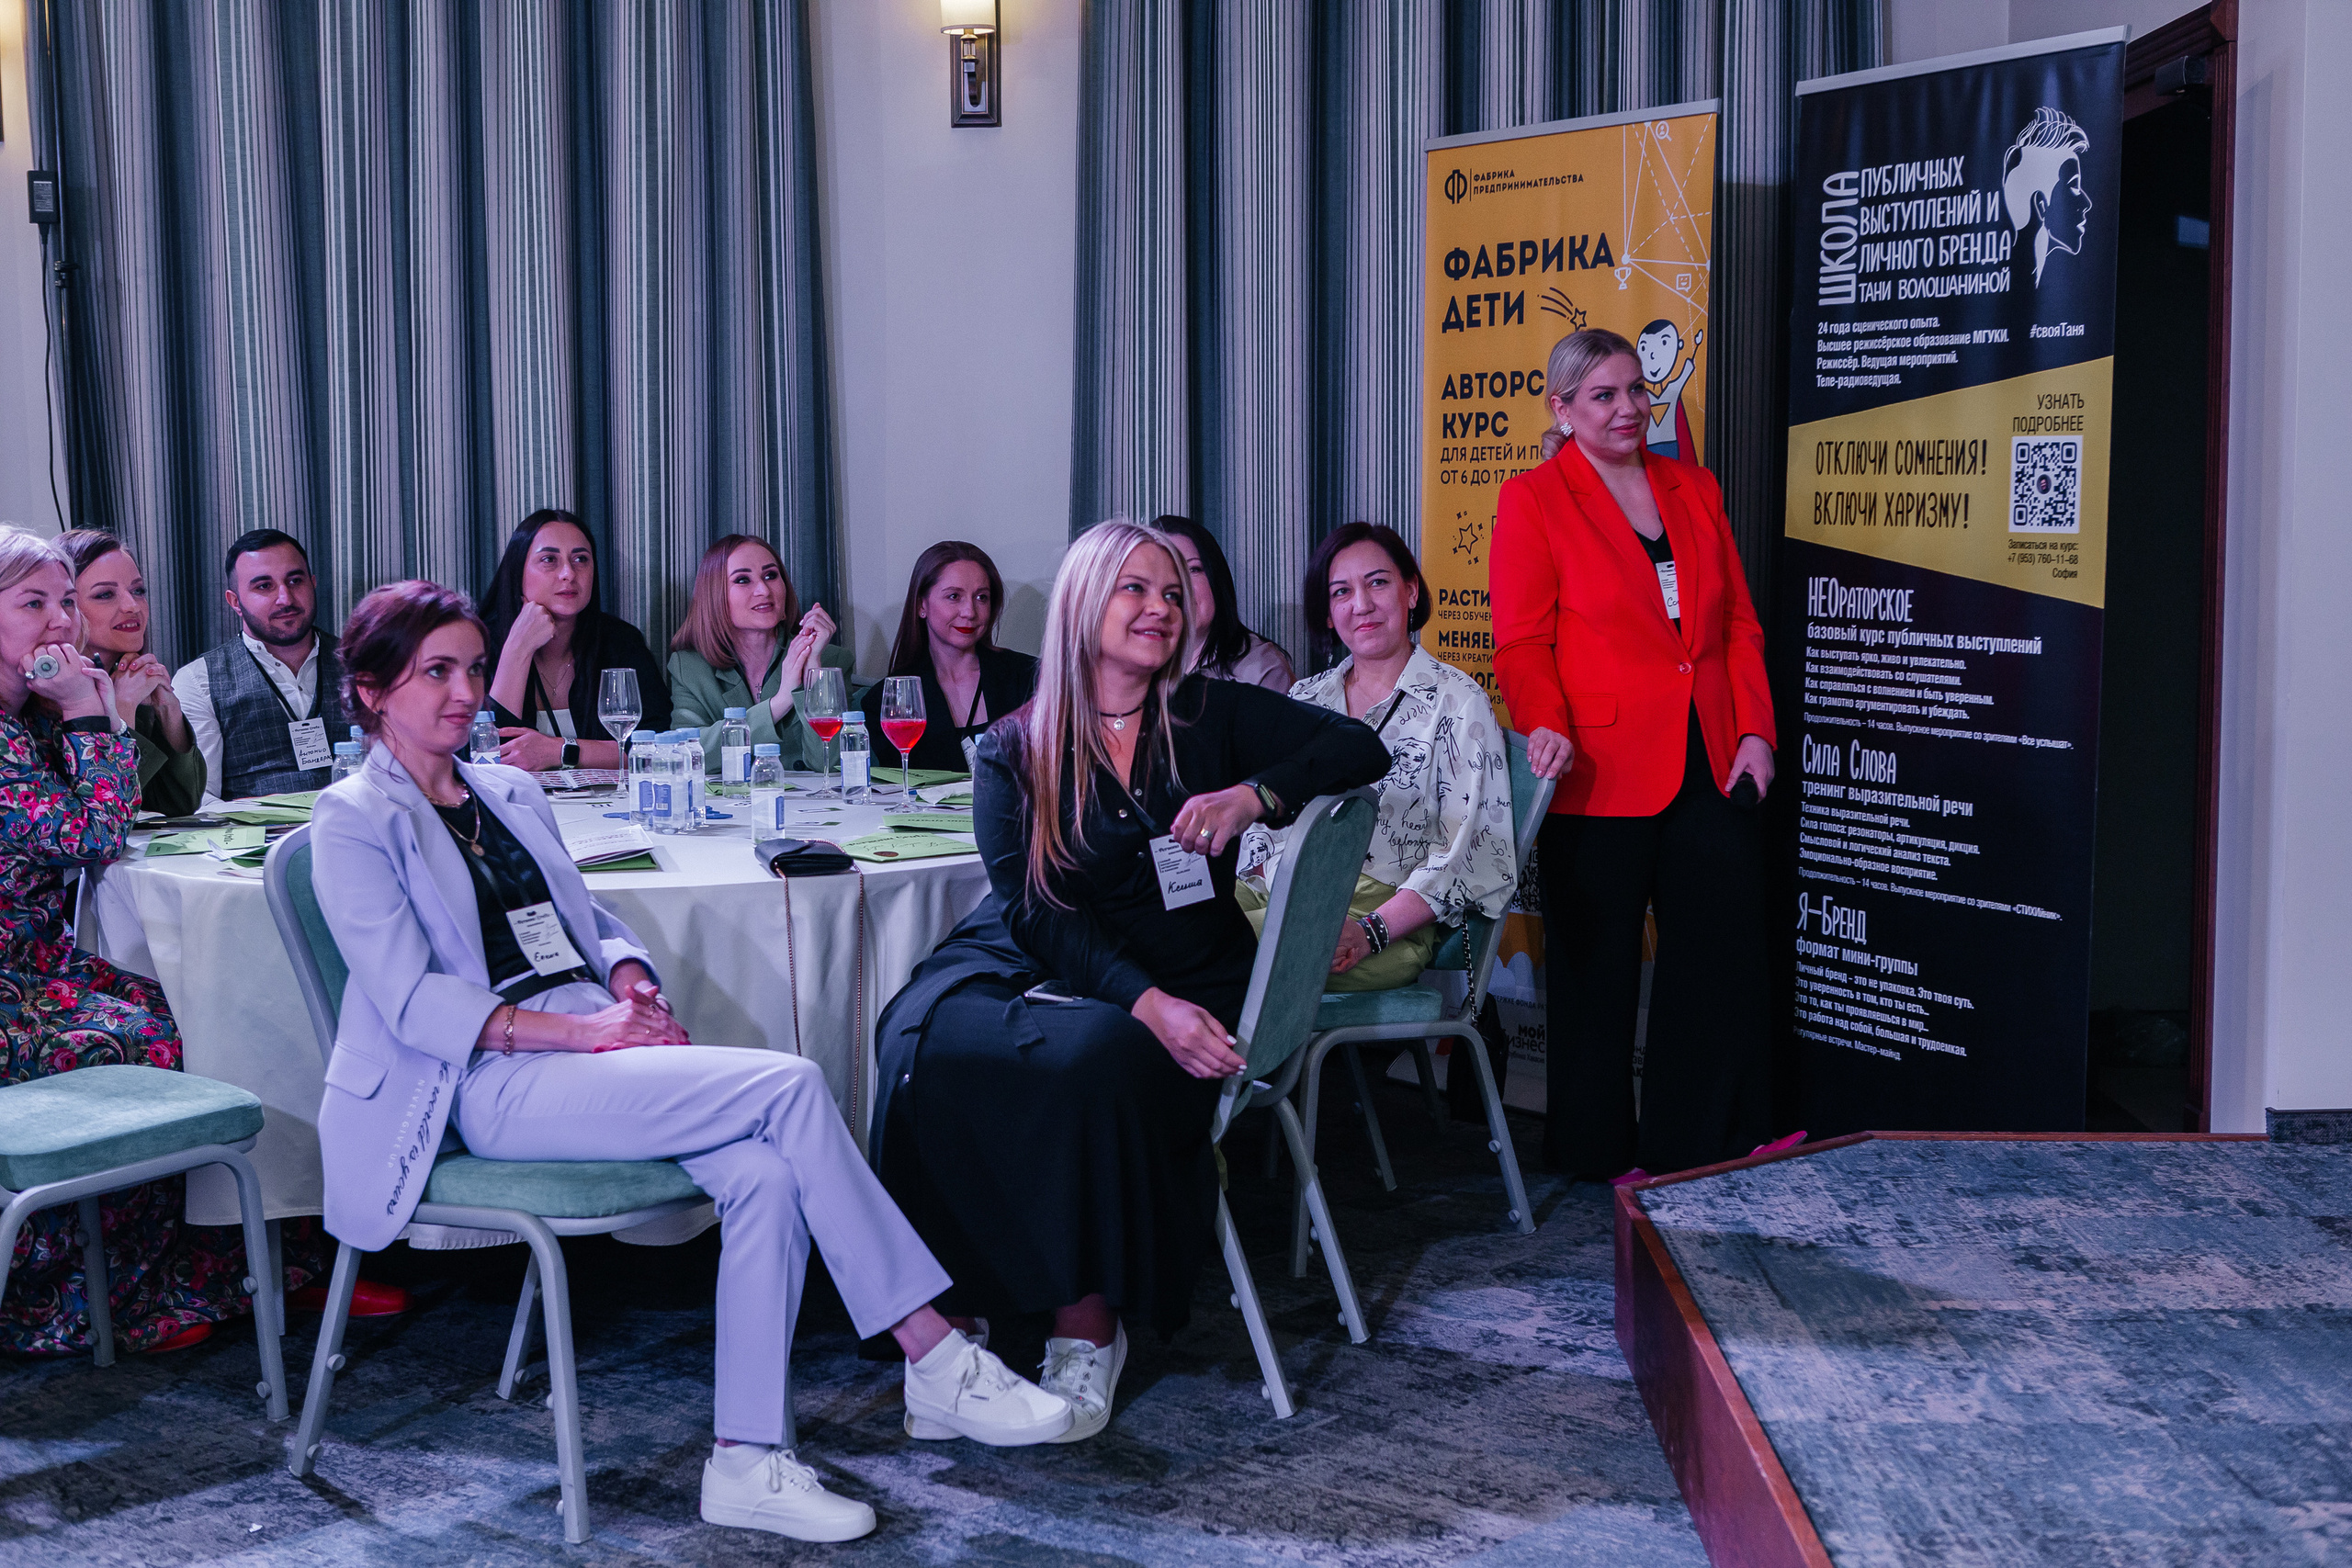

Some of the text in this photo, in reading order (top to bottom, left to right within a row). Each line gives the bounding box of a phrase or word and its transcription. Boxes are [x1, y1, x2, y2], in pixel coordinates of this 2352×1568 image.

[1474, 169, 1515, 183] ФАБРИКА
[1474, 174, 1584, 195] ПРЕДПРИНИМАТЕЛЬСТВА
[1861, 155, 1964, 198] ПУБЛИЧНЫХ
[1860, 189, 1999, 235] ВЫСТУПЛЕНИЙ И
[1819, 171, 1860, 305] ШКОЛА
[1859, 230, 2011, 274] ЛИЧНОГО БРЕНДА
[1443, 231, 1615, 281] ФАБРИКА
[1859, 266, 2010, 302] ТАНИ ВОЛОШАНИНОЙ
[1442, 290, 1524, 333] ДЕТИ
[1817, 316, 1940, 335] 24 года сценического опыта.
[1817, 329, 2009, 353] Высшее режиссёрское образование МГУКИ.
[2030, 322, 2084, 338] #свояТаня
[1816, 350, 1958, 371] Режиссёр. Ведущая мероприятий.
[1816, 374, 1902, 389] Теле-радиоведущая.
[2038, 393, 2084, 410] УЗНАТЬ
[1442, 412, 1509, 439] КУРС
[2012, 415, 2084, 434] ПОДРОБНЕЕ
[1441, 447, 1466, 463] ДЛЯ
[1470, 443, 1512, 463] ДЕТЕЙ
[1517, 446, 1525, 459] И
[1816, 439, 1986, 476] ОТКЛЮЧИ СОМНЕНИЯ!
[1441, 470, 1458, 484] ОТ
[1461, 470, 1468, 484] 6
[1470, 470, 1490, 487] ДО
[1494, 469, 1505, 483] 17
[1814, 491, 1969, 529] ВКЛЮЧИ ХАРИЗМУ!
[2007, 553, 2016, 562] +7
[2008, 538, 2047, 549] Записаться
[2060, 542, 2078, 553] курс:
[2052, 568, 2077, 580] София
[1439, 610, 1461, 620] ЧЕРЕЗ
[1807, 621, 2041, 655] базовый курс публичных выступлений
[1438, 652, 1461, 661] ЧЕРЕЗ
[1806, 646, 1966, 670] Как выступать ярко, живо и увлекательно.
[1805, 661, 1962, 685] Как взаимодействовать со слушателями.
[1804, 676, 1994, 705] Как справляться с волнением и быть уверенным.
[1804, 692, 1970, 719] Как грамотно аргументировать и убеждать.
[1802, 781, 1973, 817] тренинг выразительной речи
[1801, 801, 1910, 828] Техника выразительной речи.
[1800, 816, 1980, 854] Сила голоса: резонаторы, артикуляция, дикция.
[1800, 831, 1951, 866] Смысловой и логический анализ текста.
[1799, 847, 1938, 880] Эмоционально-образное восприятие.
[1796, 937, 1917, 976] формат мини-группы
[1795, 961, 1974, 1009] Личный бренд это не упаковка. Это твоя суть.
[1796, 976, 1808, 988] Это
[1809, 981, 1854, 998] уверенность
[1856, 991, 1860, 1000] в
[1861, 992, 1878, 1006] том,
[1879, 997, 1893, 1008] кто
[1894, 999, 1905, 1010] ты
[1795, 991, 1807, 1003] Это
[1808, 996, 1818, 1008] то,
[1819, 998, 1833, 1010] как
[1834, 1001, 1844, 1012] ты
[1845, 1005, 1900, 1025] проявляешься
[1901, 1017, 1906, 1027] в
[1795, 1007, 1967, 1056] Это работа над собой, большая и трудоемкая.
[388, 1079, 425, 1168] NEVER GIVE UP
